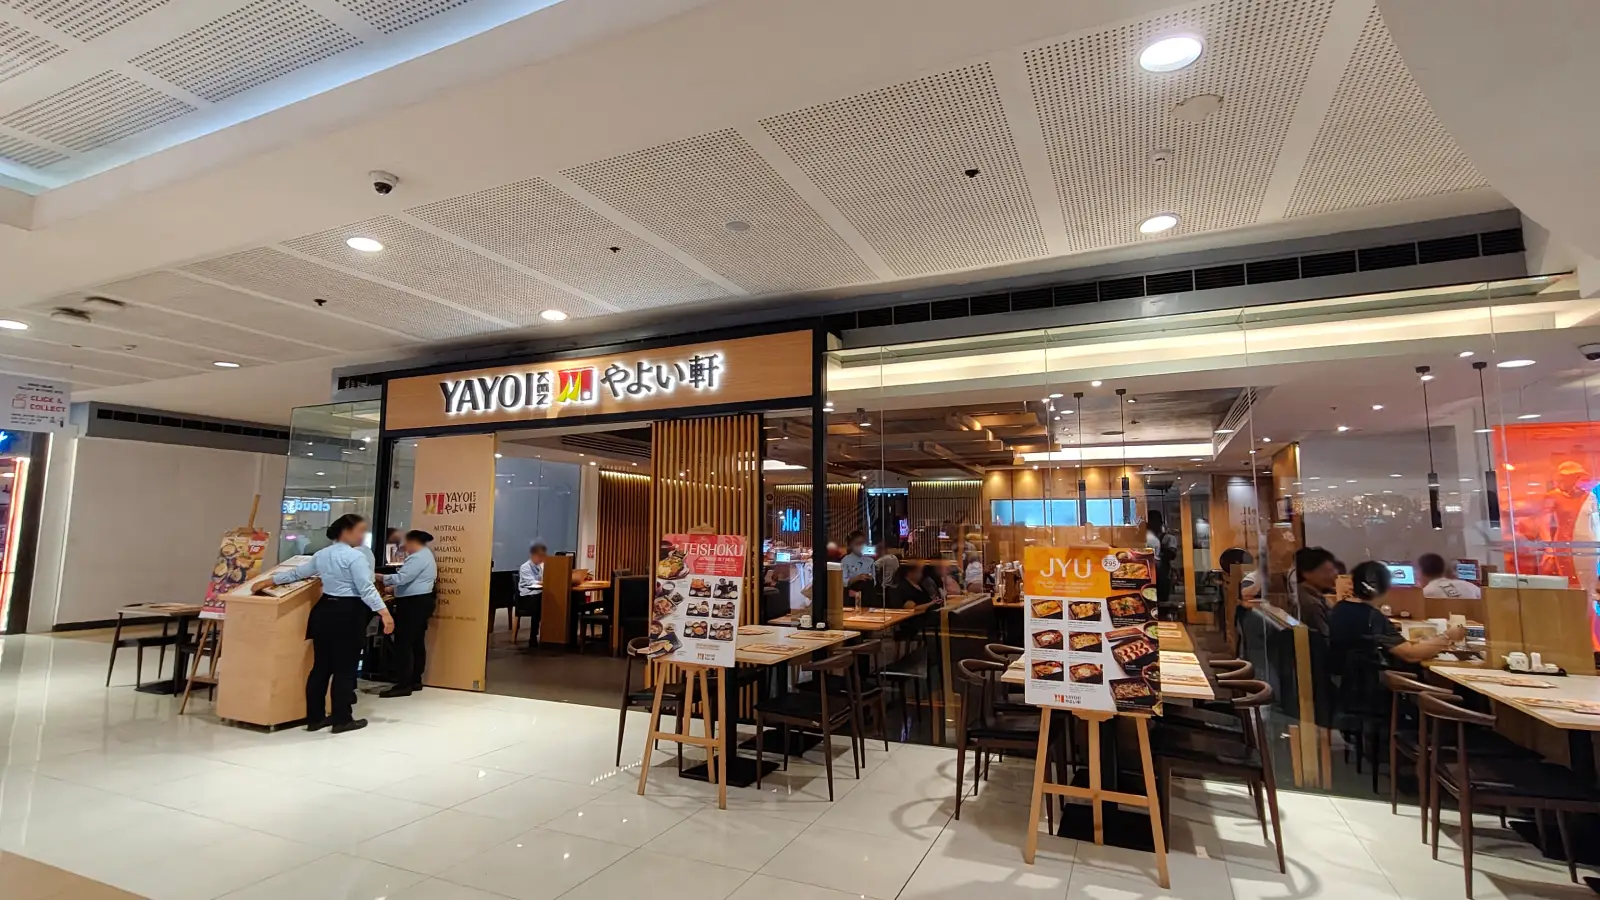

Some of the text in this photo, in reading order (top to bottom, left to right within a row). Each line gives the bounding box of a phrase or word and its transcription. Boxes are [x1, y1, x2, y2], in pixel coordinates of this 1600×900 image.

[600, 353, 720, 398] やよい軒
[439, 371, 550, 413] YAYOI KEN
[30, 395, 54, 403] CLICK
[30, 403, 66, 413] COLLECT
[446, 492, 472, 502] YAYOI
[444, 502, 477, 514] やよい軒
[433, 524, 465, 532] AUSTRALIA
[682, 542, 744, 557] TEISHOKU
[1040, 557, 1092, 579] JYU
